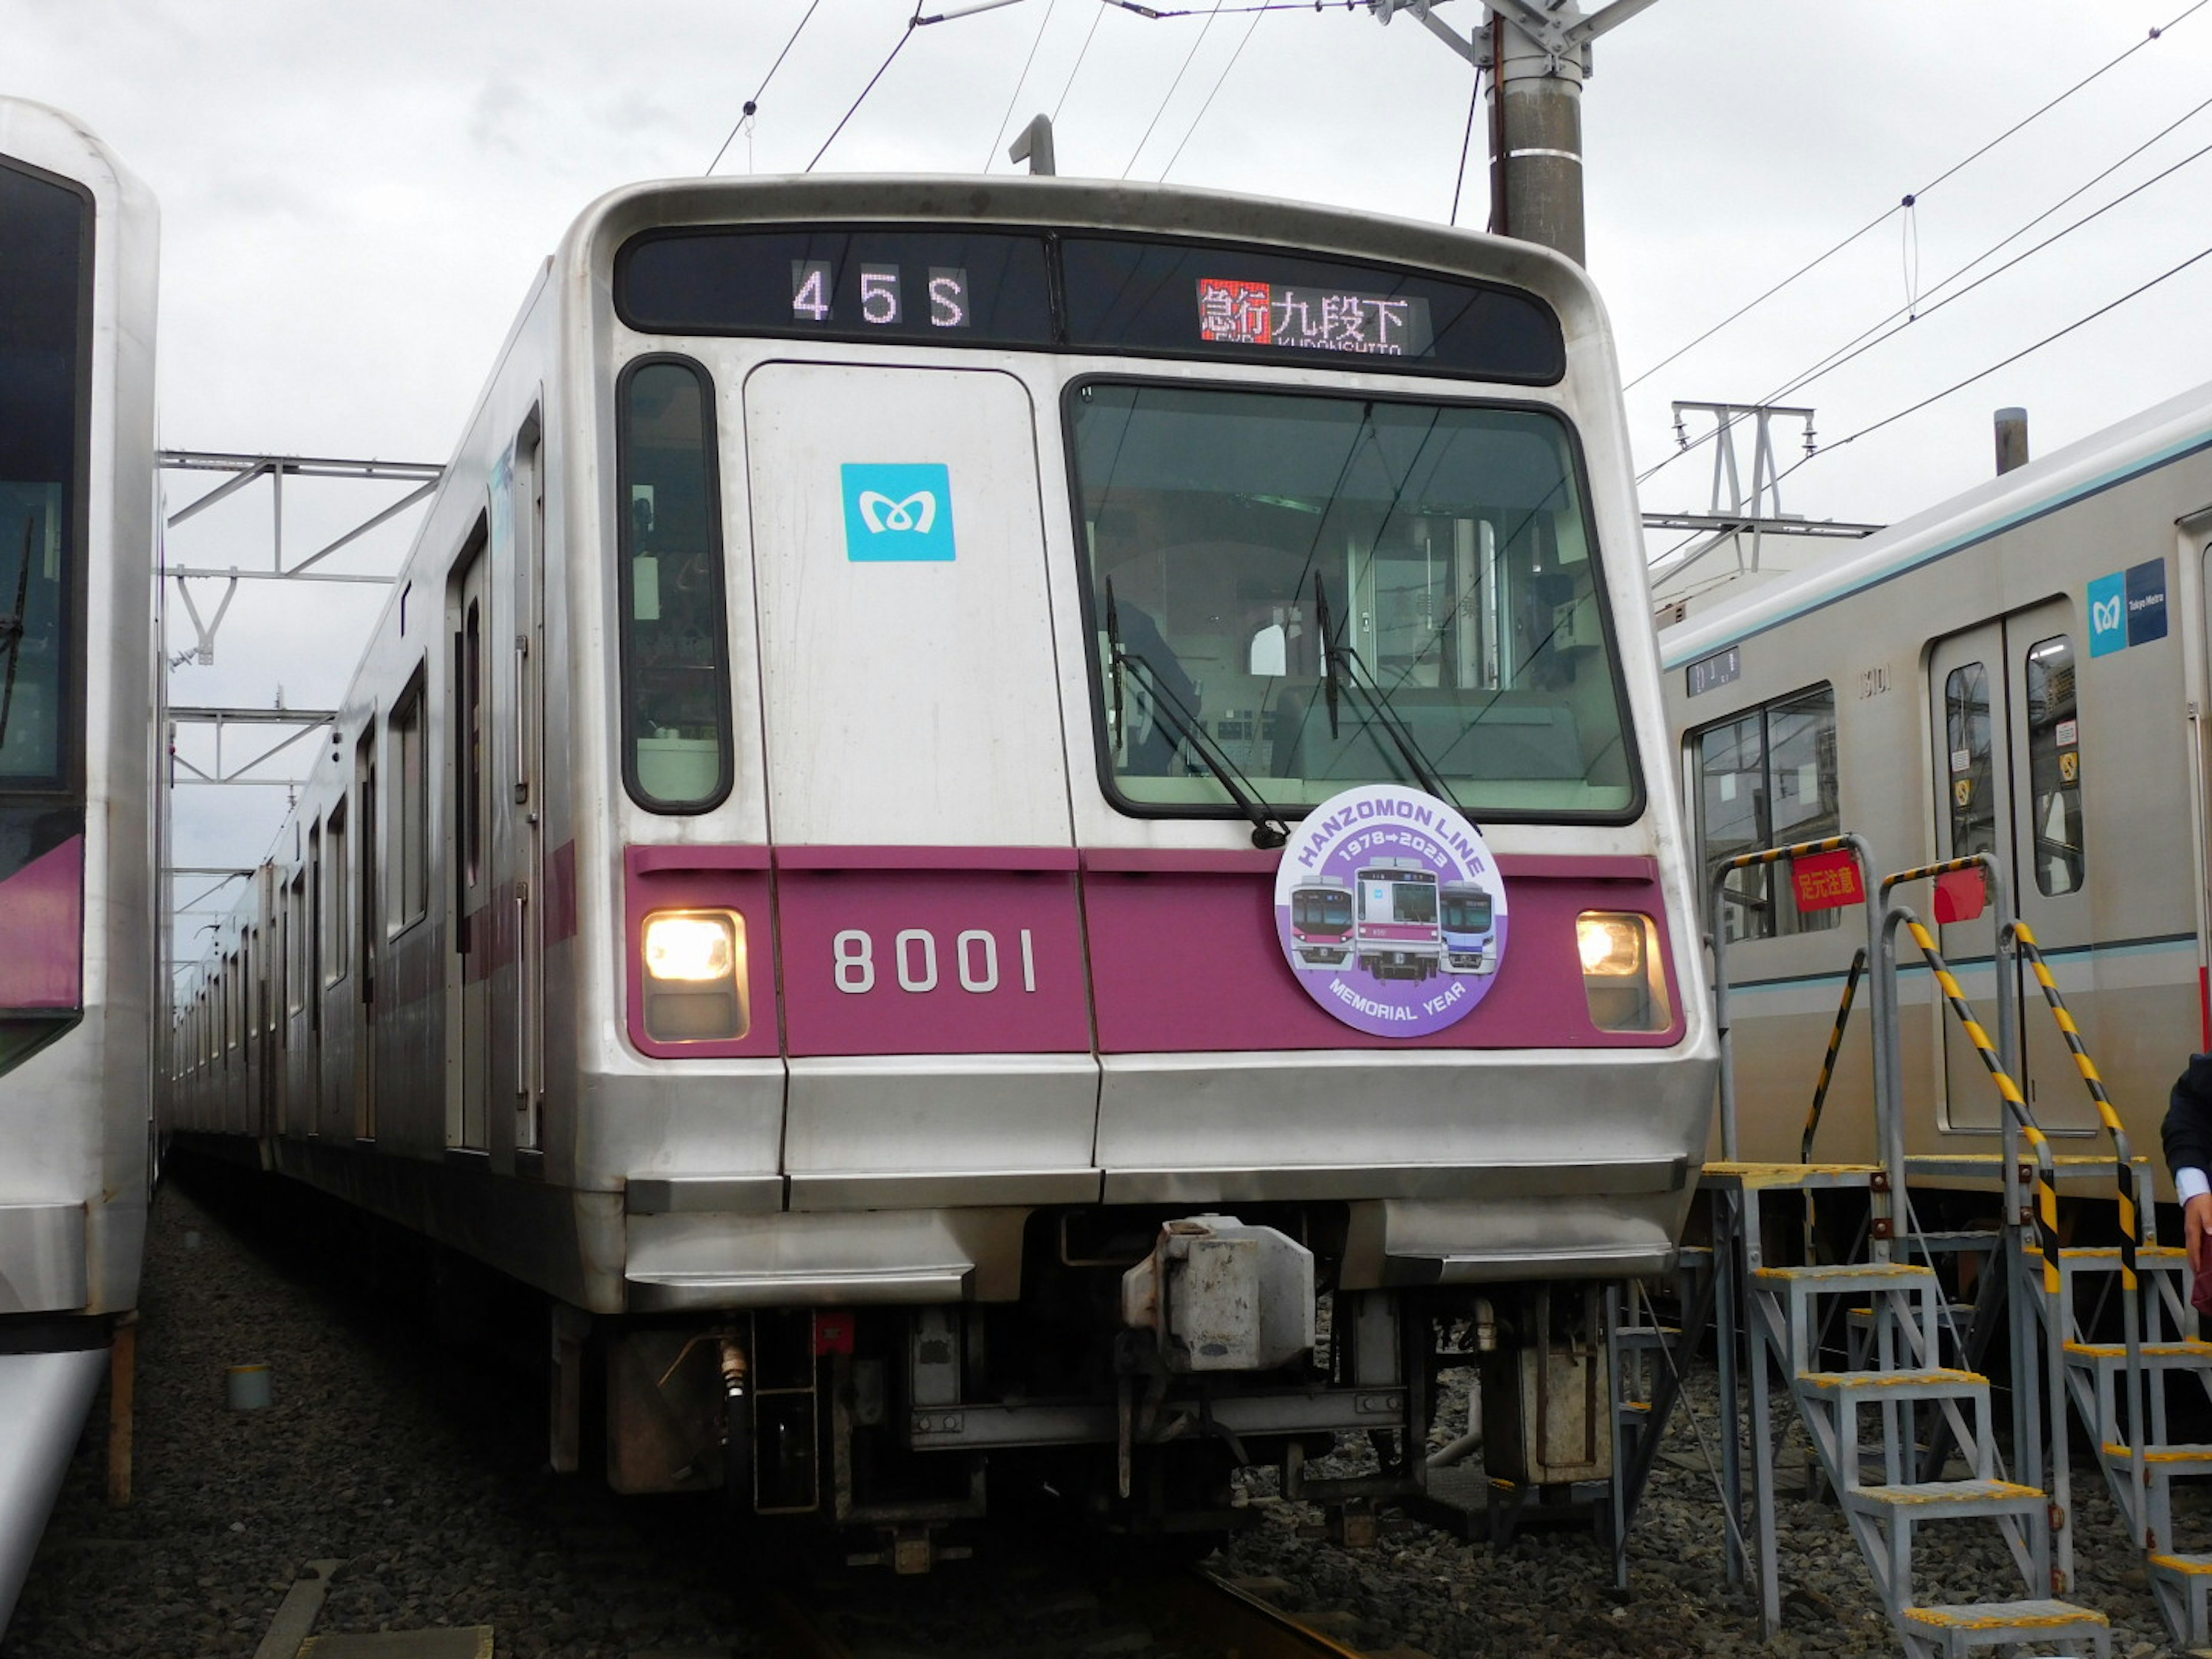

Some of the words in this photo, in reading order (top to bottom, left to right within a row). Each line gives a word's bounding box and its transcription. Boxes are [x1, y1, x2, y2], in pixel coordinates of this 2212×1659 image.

[1202, 285, 1268, 334] 急行
[1271, 291, 1408, 343] 九段下
[1298, 798, 1433, 868] HANZOMON
[1434, 819, 1486, 878] LINE
[1798, 866, 1855, 901] 足元注意
[833, 929, 1036, 993] 8001
[1329, 978, 1418, 1021] MEMORIAL
[1422, 981, 1467, 1017] YEAR
